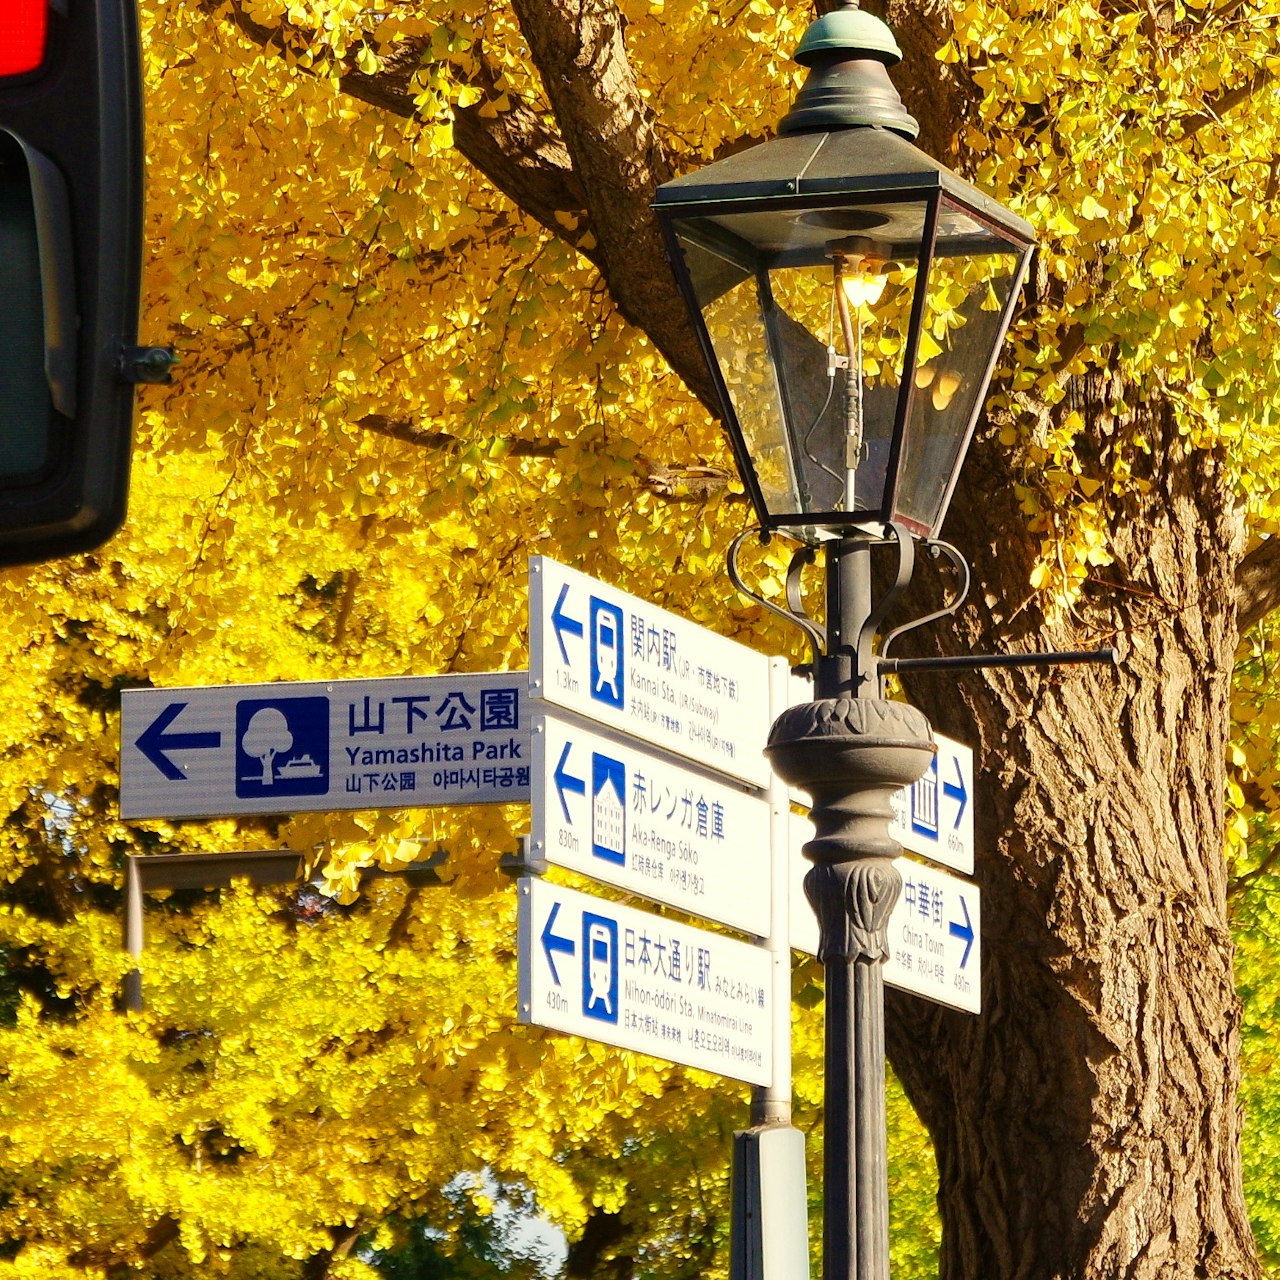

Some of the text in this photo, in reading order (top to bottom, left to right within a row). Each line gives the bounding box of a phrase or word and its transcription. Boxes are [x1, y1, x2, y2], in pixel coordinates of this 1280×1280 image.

[630, 614, 677, 675] 関内駅
[555, 669, 580, 694] 1.3km
[631, 667, 659, 696] Kannai
[662, 680, 677, 704] Sta.
[348, 688, 520, 736] 山下公園
[346, 738, 521, 767] Yamashita Park
[345, 771, 416, 793] 山下公园
[433, 765, 530, 790] 야마시타공원
[632, 768, 725, 844] 赤レンガ倉庫
[558, 828, 580, 852] 830m
[631, 823, 676, 861] Aka-Renga
[947, 833, 965, 855] 660m
[905, 875, 944, 929] 中華街
[902, 924, 945, 958] China Town
[624, 928, 765, 1008] 日本大通り駅 みなとみらい線
[953, 973, 971, 995] 490m
[546, 989, 569, 1014] 430m
[679, 995, 695, 1019] Sta.
[697, 1005, 738, 1030] Minatomirai
[739, 1018, 753, 1035] Line
